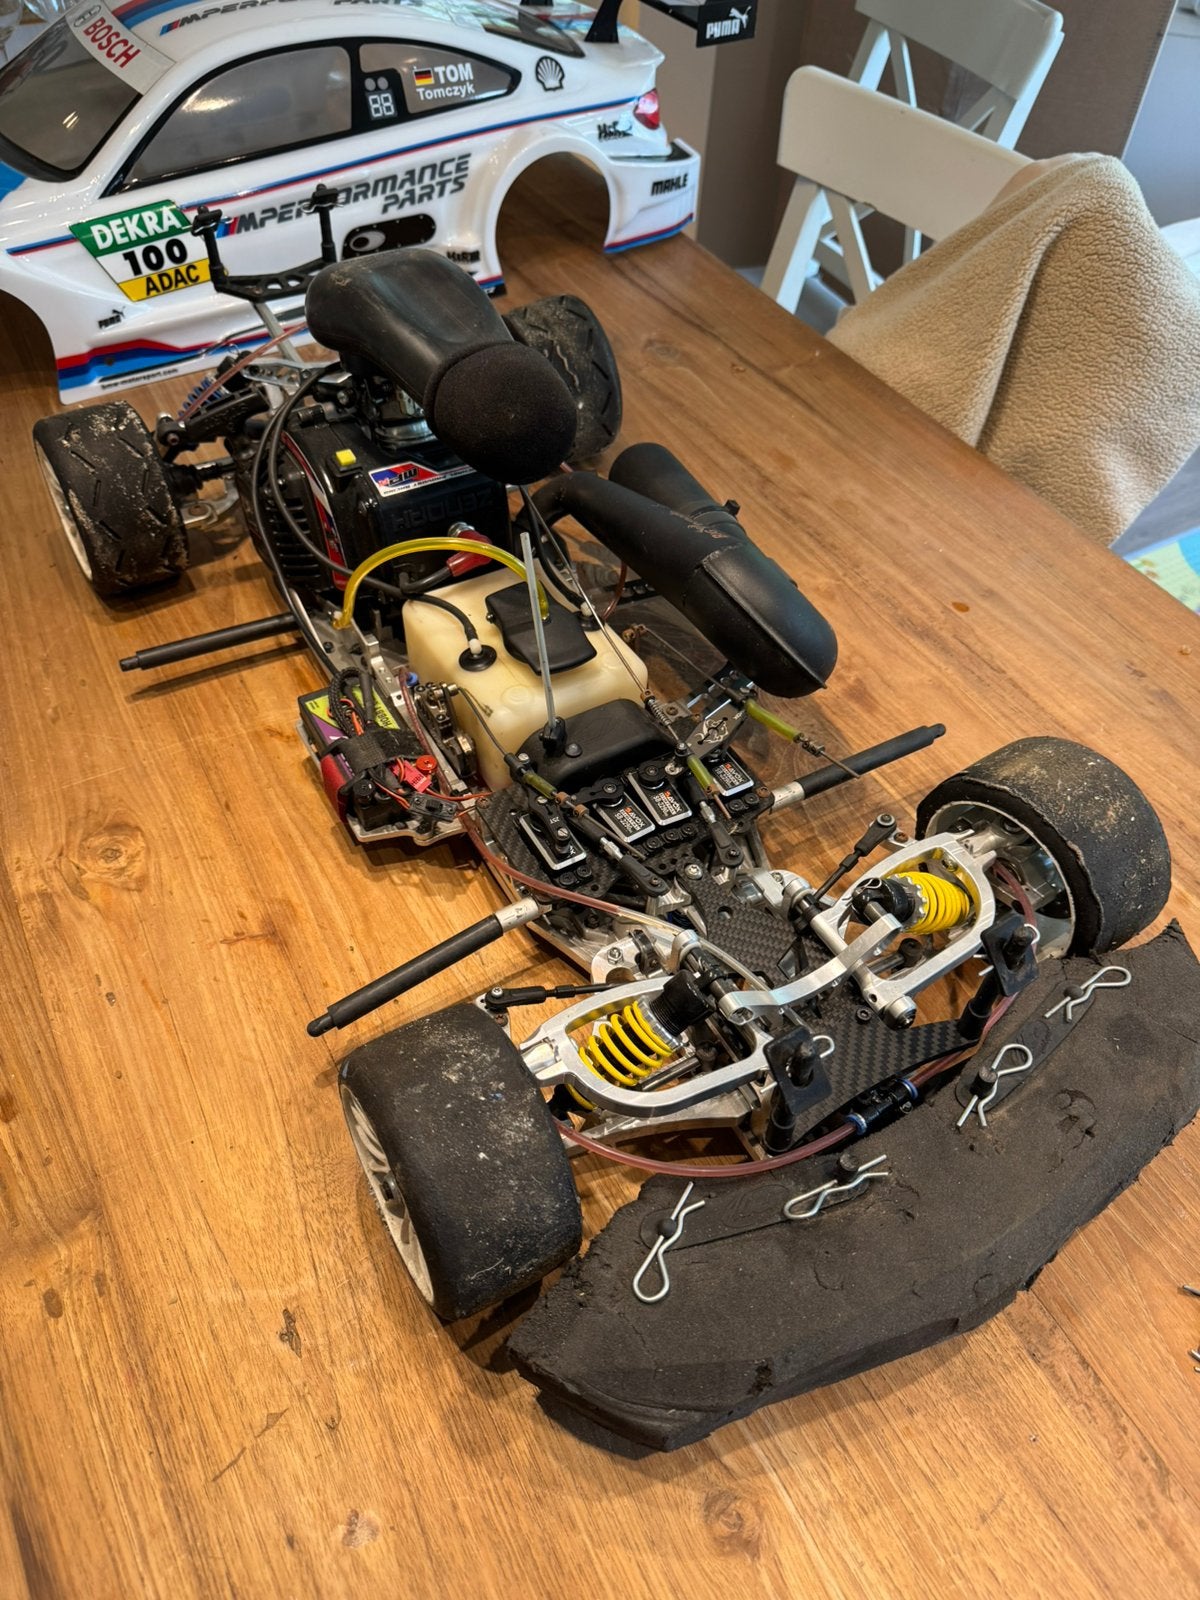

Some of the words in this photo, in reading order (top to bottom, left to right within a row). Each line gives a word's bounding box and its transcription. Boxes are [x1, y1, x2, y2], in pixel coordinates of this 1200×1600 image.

[83, 16, 141, 69] BOSCH
[706, 18, 741, 39] PUMA
[434, 62, 474, 84] TOM
[416, 81, 476, 101] Tomczyk
[381, 173, 469, 215] PARTS
[650, 172, 689, 197] MAHLE
[90, 205, 182, 251] DEKRA
[122, 238, 188, 277] 100
[145, 264, 201, 297] ADAC
[624, 806, 646, 828] SAVOX
